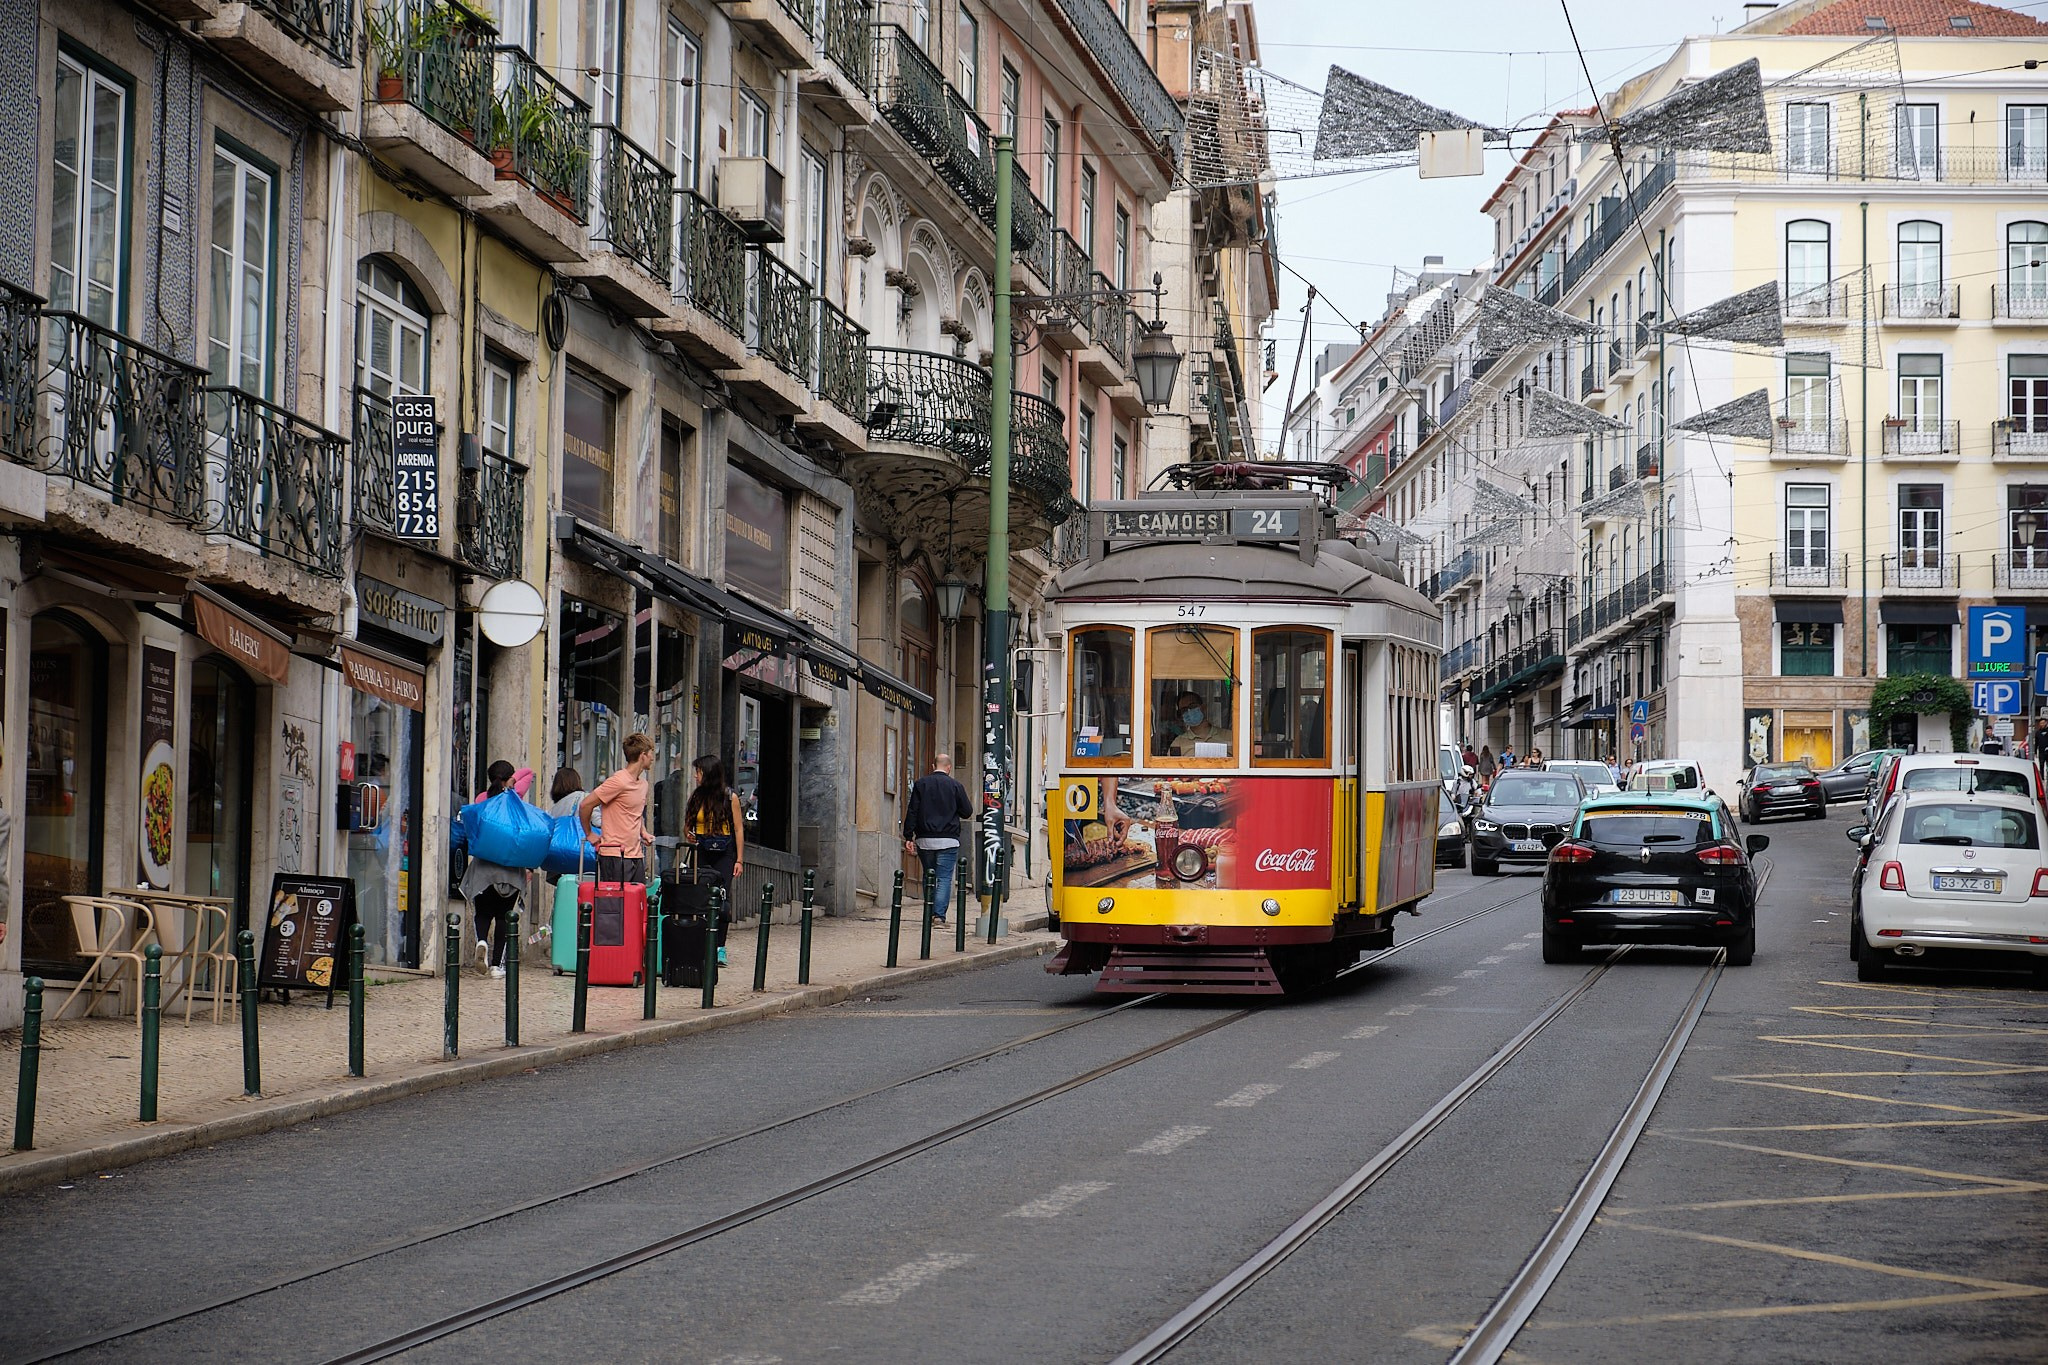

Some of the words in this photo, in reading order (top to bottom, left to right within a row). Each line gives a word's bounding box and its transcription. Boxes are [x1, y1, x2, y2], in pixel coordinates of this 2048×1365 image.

[395, 403, 433, 417] casa
[396, 420, 433, 439] pura
[397, 453, 435, 467] ARRENDA
[397, 470, 435, 490] 215
[398, 492, 436, 512] 854
[398, 513, 437, 534] 728
[1115, 513, 1131, 530] L.
[1138, 511, 1218, 531] CAMÕES
[1252, 510, 1283, 534] 24
[364, 588, 439, 634] SORBETTINO
[1178, 605, 1206, 617] 547
[1982, 619, 2012, 657] P
[1976, 662, 2011, 673] LIVRE
[1994, 684, 2013, 712] P
[824, 715, 837, 727] 33
[1076, 747, 1087, 756] 03
[1686, 812, 1706, 820] 528
[1255, 848, 1318, 872] Coca-Cola
[297, 886, 325, 895] Almoço
[319, 903, 325, 912] 5
[282, 924, 288, 932] 5
